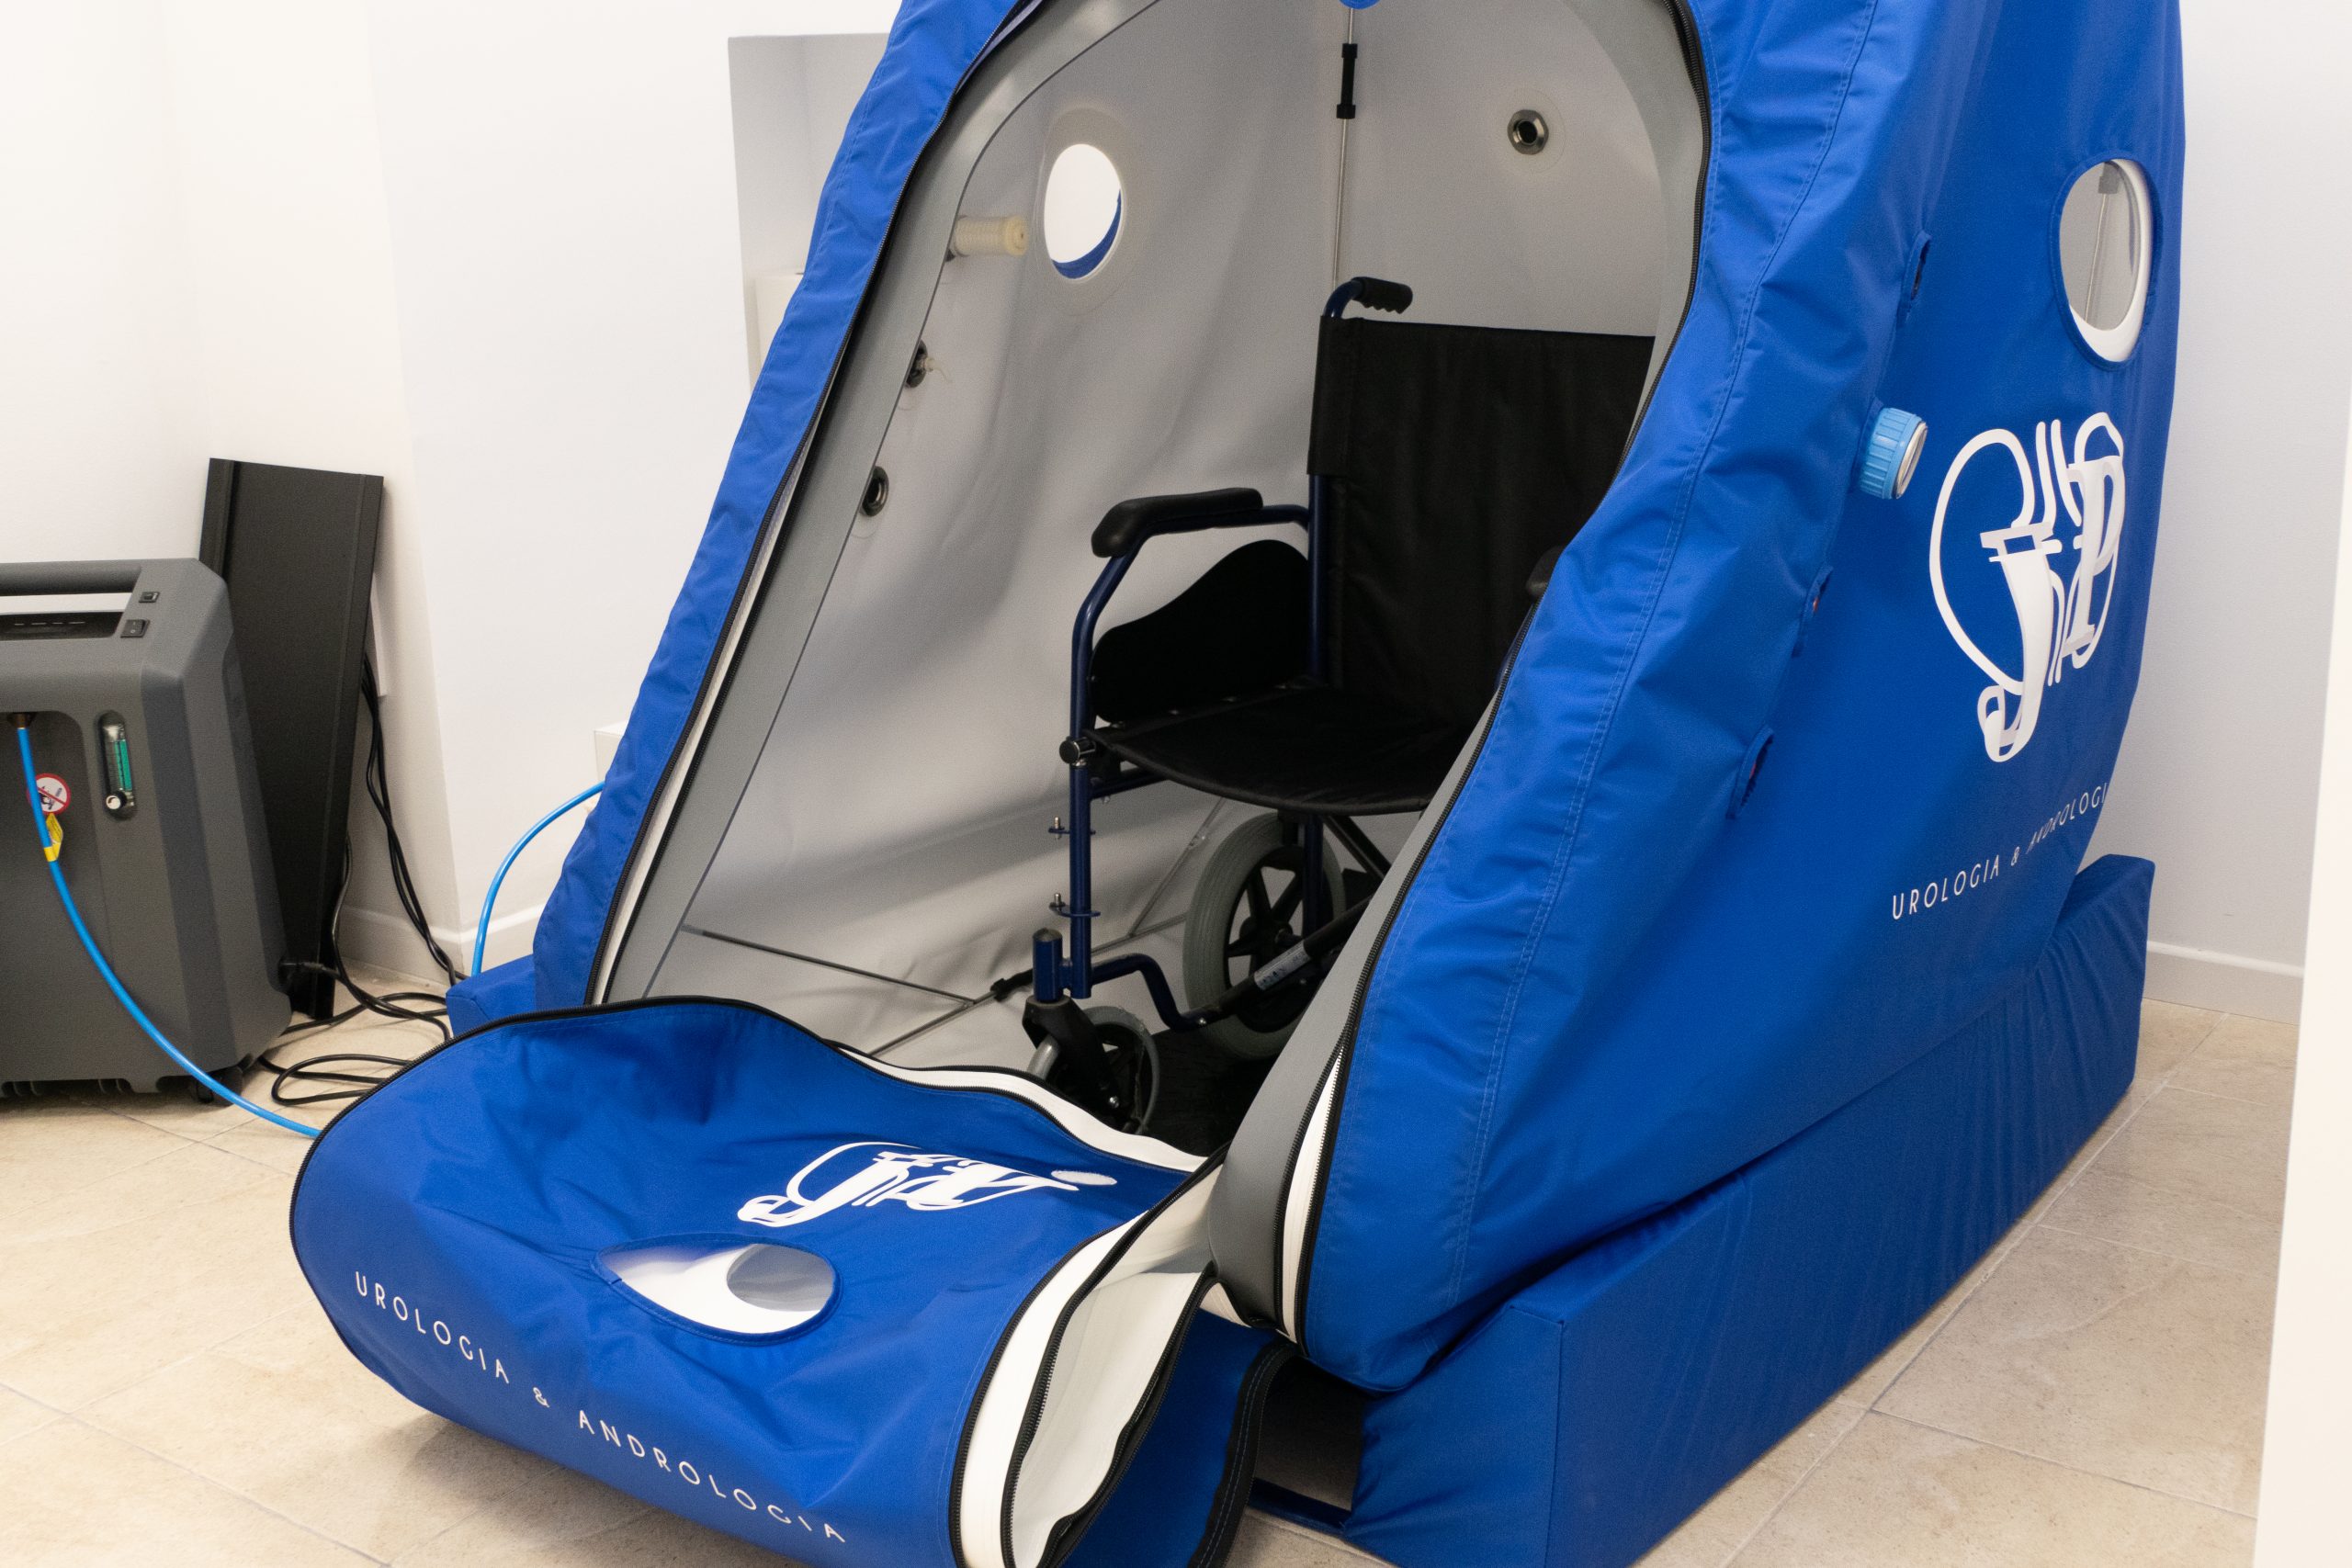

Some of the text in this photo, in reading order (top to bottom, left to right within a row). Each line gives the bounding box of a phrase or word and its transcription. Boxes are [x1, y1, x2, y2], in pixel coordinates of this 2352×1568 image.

[1892, 854, 1999, 919] UROLOGIA
[2010, 846, 2020, 866] &
[356, 1271, 845, 1543] UROLOGIA & ANDROLOGIA
